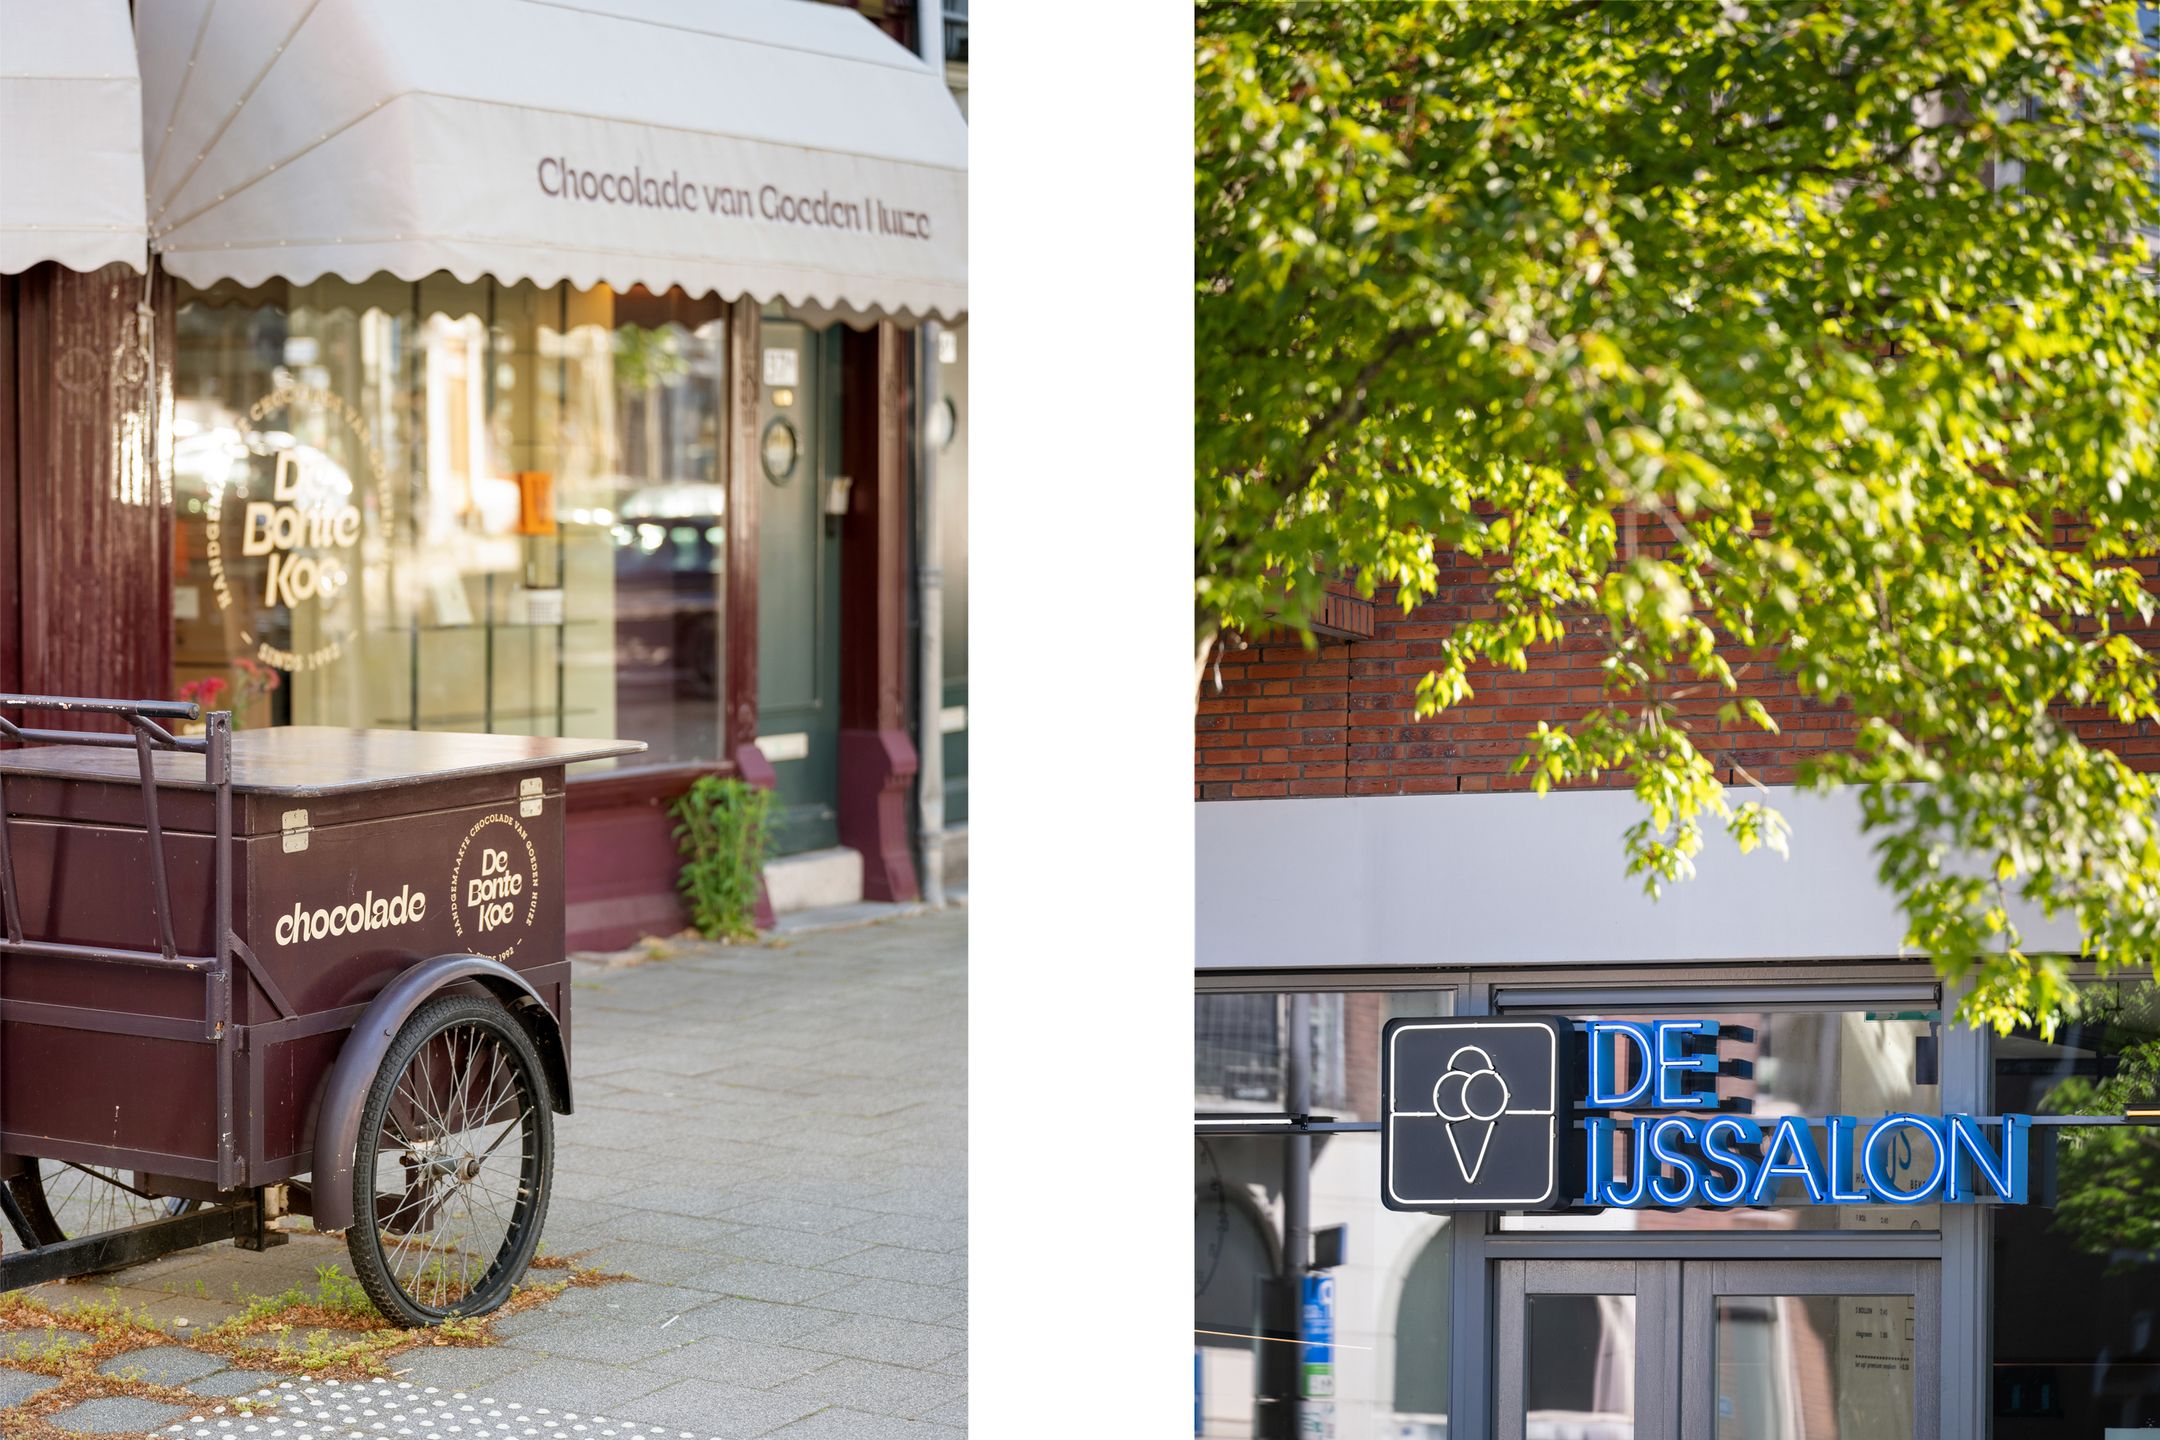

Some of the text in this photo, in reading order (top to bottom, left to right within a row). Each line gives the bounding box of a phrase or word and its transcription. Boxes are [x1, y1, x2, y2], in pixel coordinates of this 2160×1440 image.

[538, 156, 931, 240] Chocolade van Goeden Huize
[242, 499, 361, 556] Bonte
[265, 553, 343, 609] Koe
[450, 813, 539, 937] HANDGEMAAKTE CHOCOLADE VAN GOEDEN HUIZE
[467, 870, 523, 908] Bonte
[481, 848, 509, 877] De
[275, 884, 427, 946] chocolade
[478, 901, 515, 933] Koe
[1585, 1020, 1720, 1109] DE
[1584, 1113, 2032, 1206] IJSSALON
